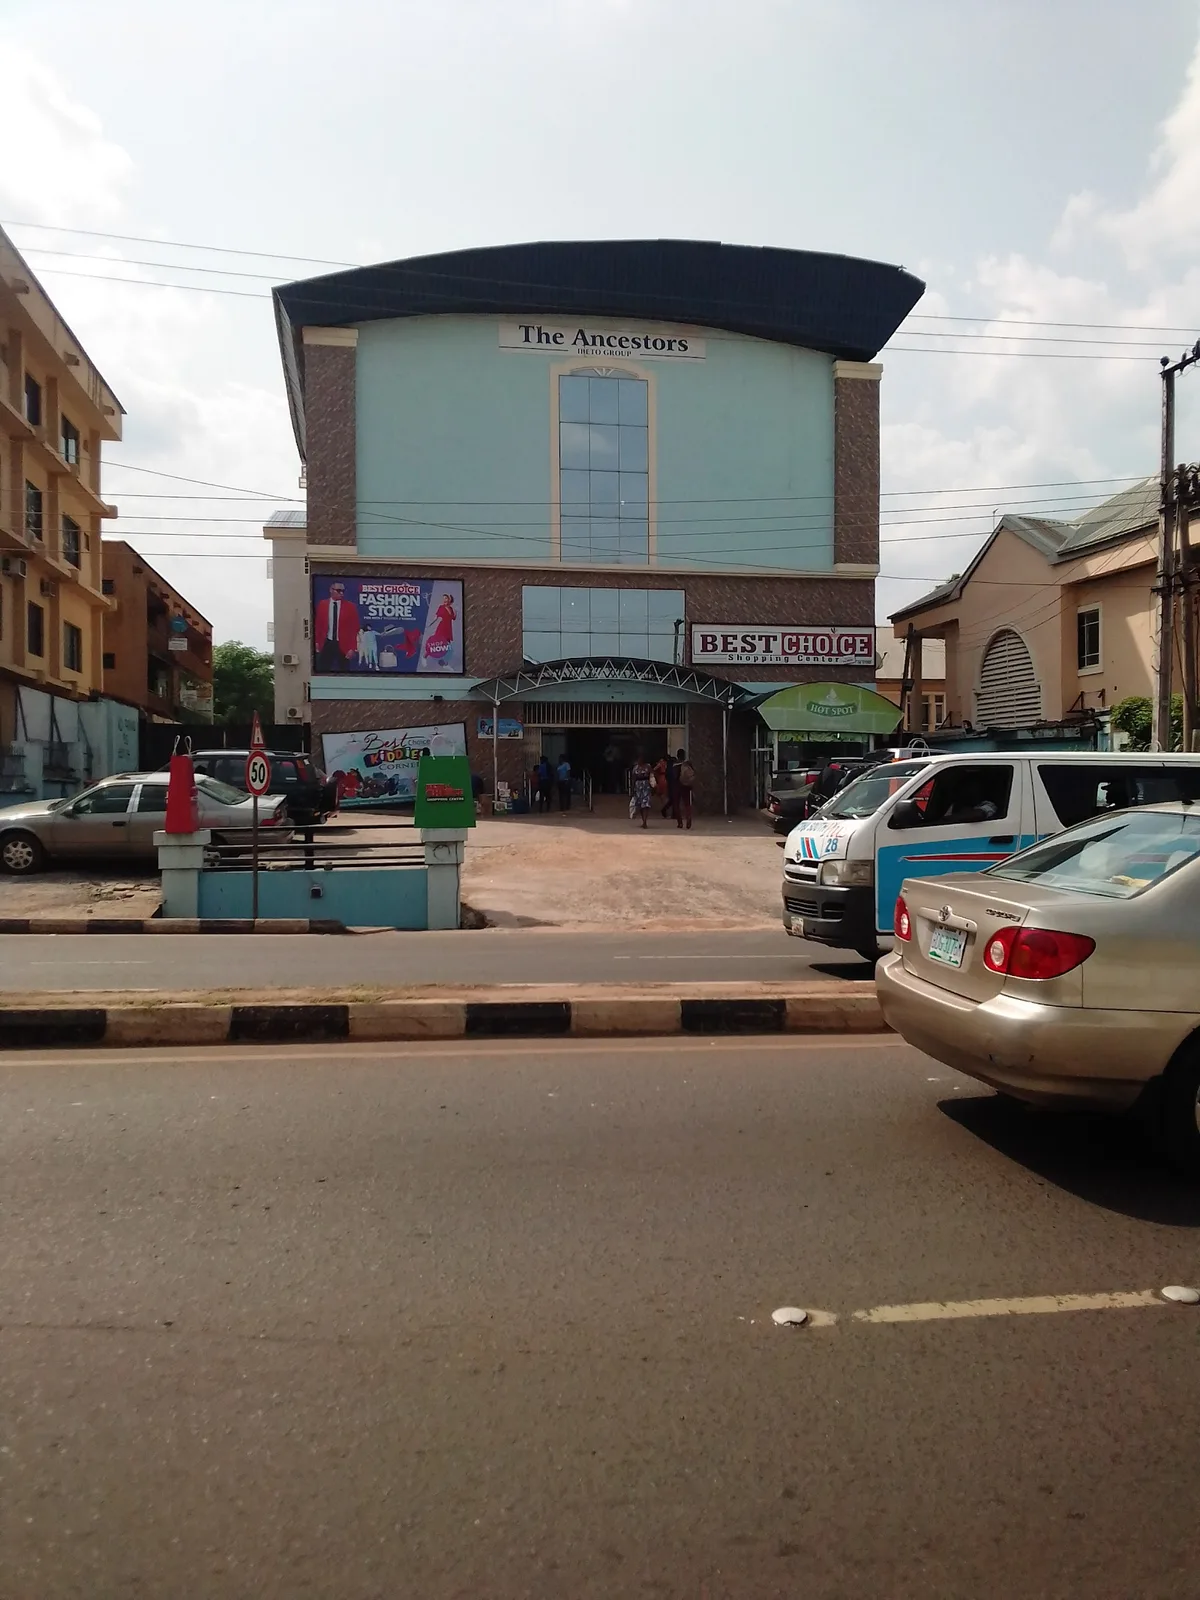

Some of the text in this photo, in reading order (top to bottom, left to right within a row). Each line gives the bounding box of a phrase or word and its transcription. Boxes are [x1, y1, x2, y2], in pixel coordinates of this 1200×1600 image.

[518, 325, 689, 352] The Ancestors
[603, 349, 632, 357] GROUP
[362, 584, 420, 594] BEST CHOICE
[359, 593, 421, 607] FASHION
[368, 605, 413, 617] STORE
[700, 633, 869, 655] BEST CHOICE
[728, 654, 790, 663] Shopping
[797, 655, 840, 663] Center
[810, 704, 855, 716] HOT SPOT
[363, 732, 424, 751] Best
[251, 762, 266, 784] 50
[825, 838, 839, 853] 28
